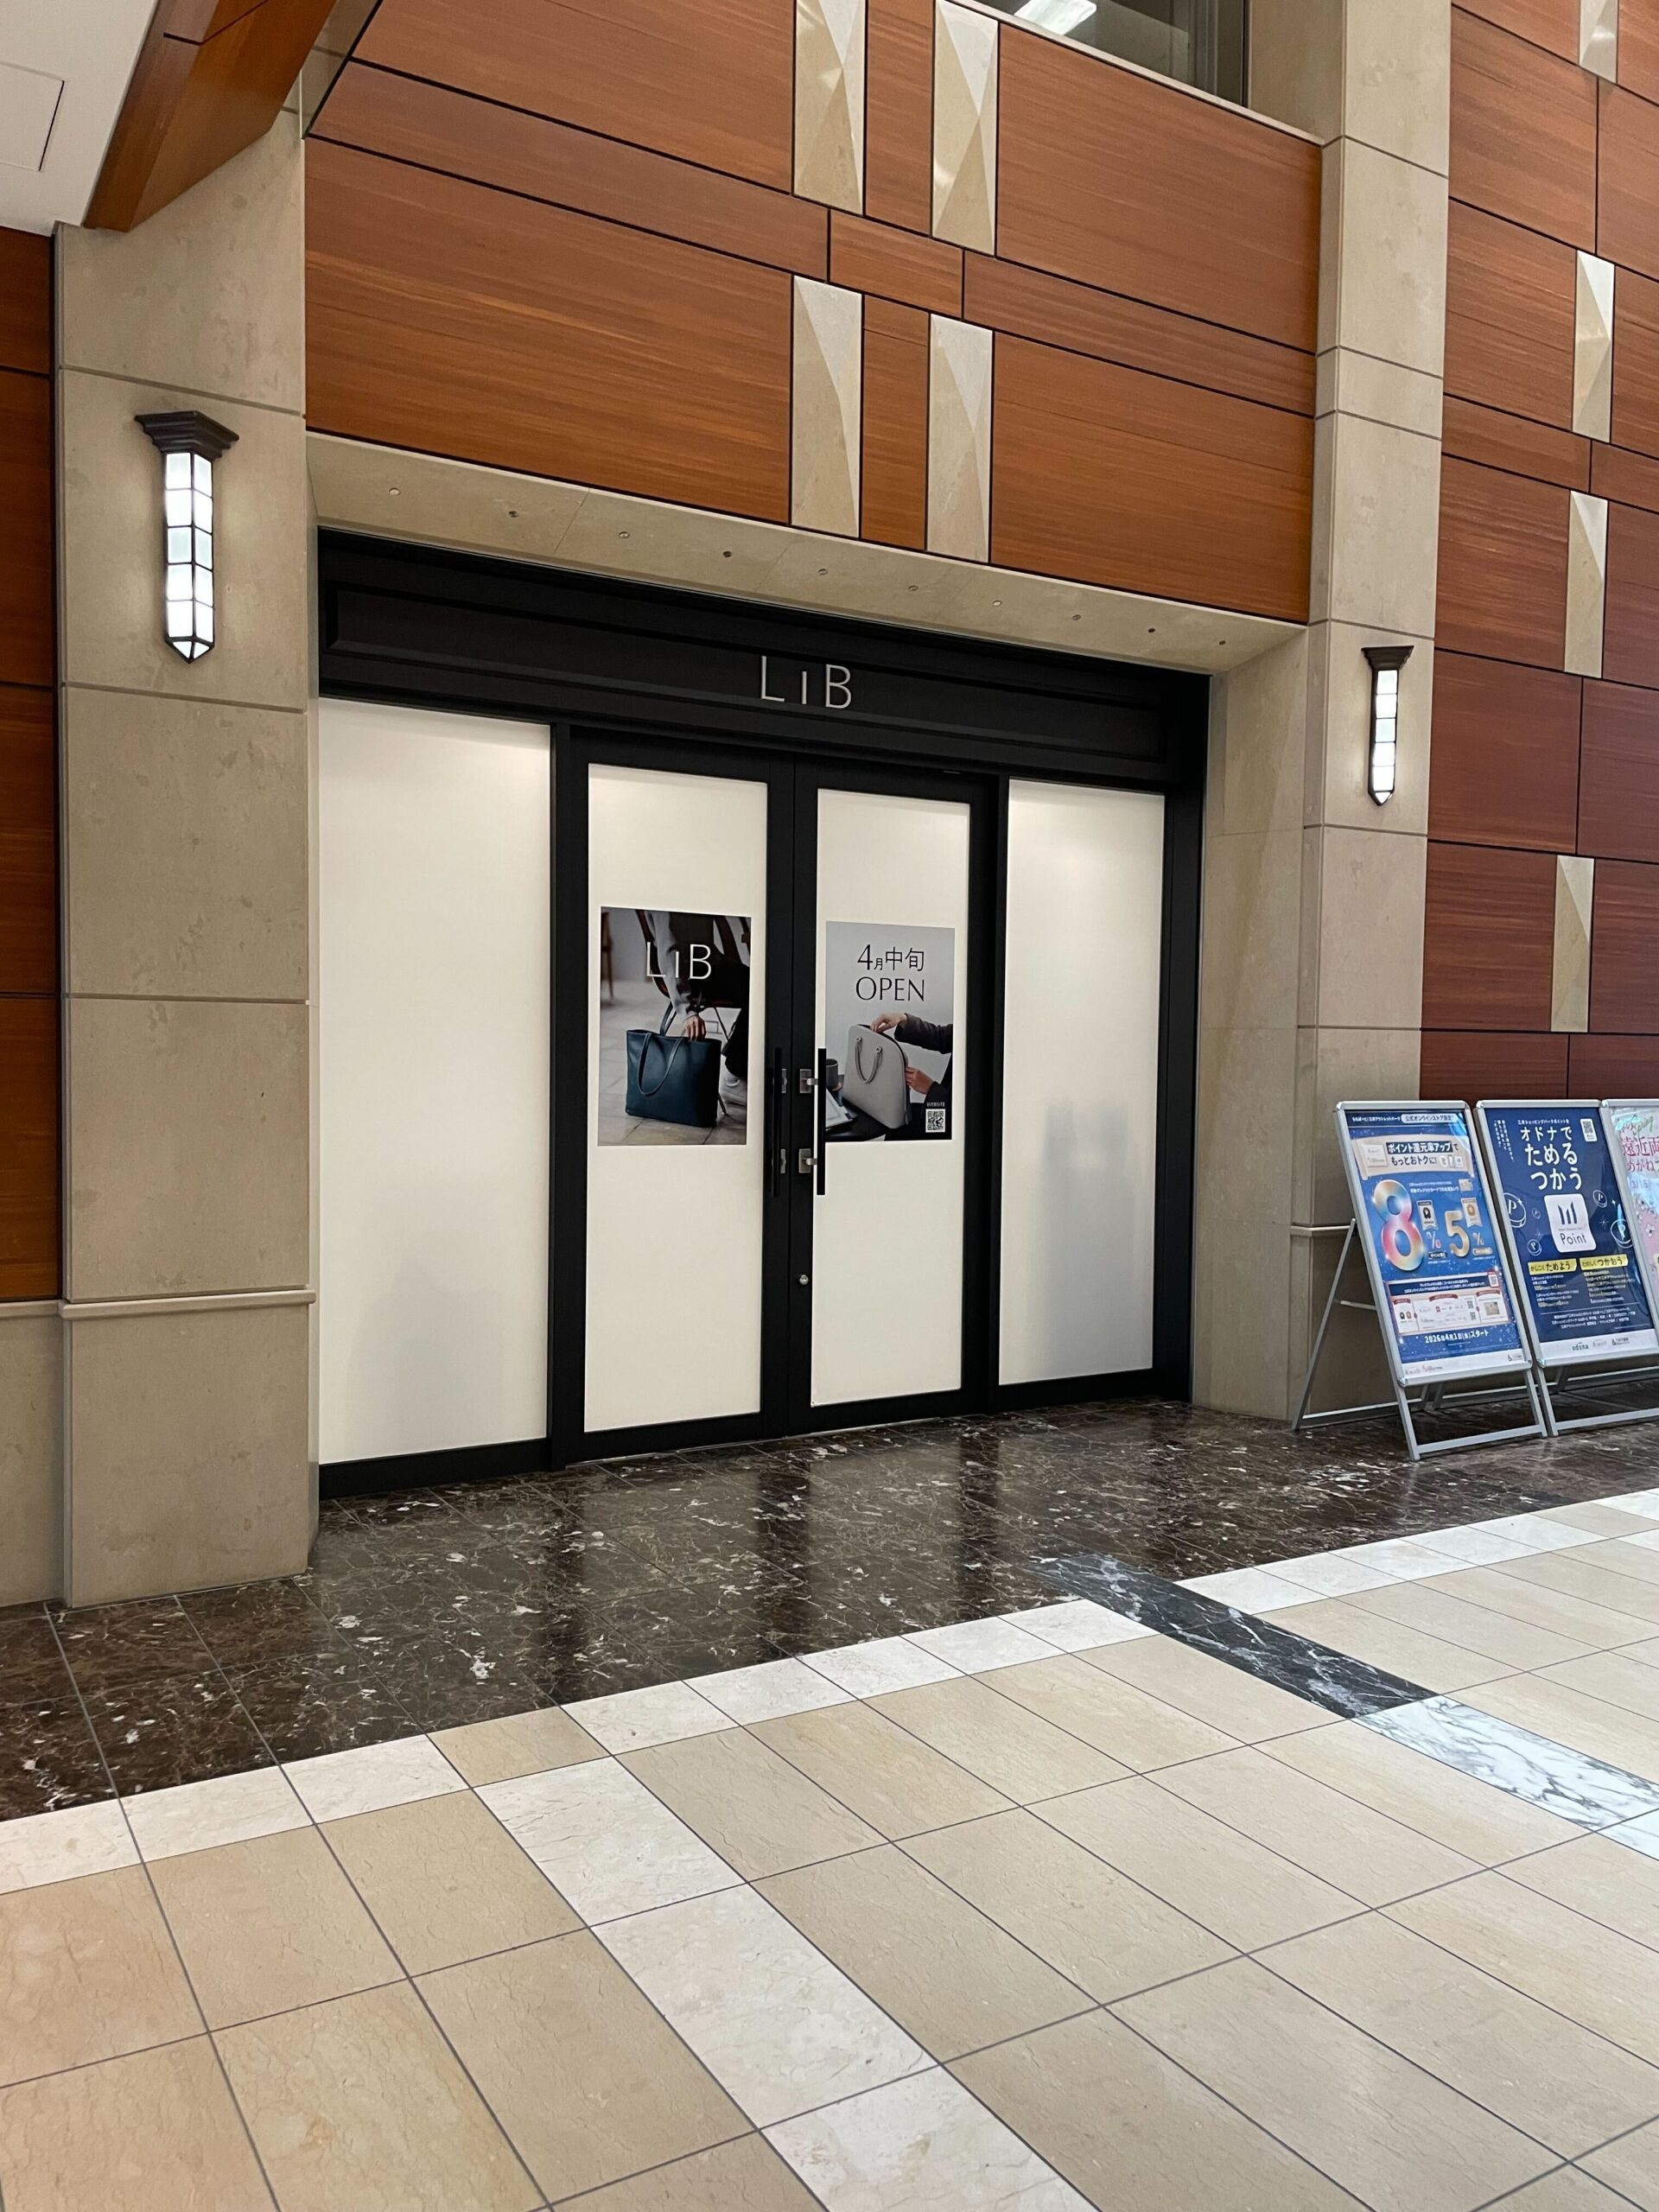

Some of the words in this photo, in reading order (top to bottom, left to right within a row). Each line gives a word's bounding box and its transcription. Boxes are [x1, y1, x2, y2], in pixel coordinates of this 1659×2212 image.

[856, 944, 925, 971] 4月中旬
[855, 976, 925, 1001] OPEN
[1520, 1126, 1573, 1141] オドナで
[1524, 1142, 1578, 1166] ためる
[1530, 1166, 1582, 1191] つかう
[1560, 1232, 1587, 1245] Point
